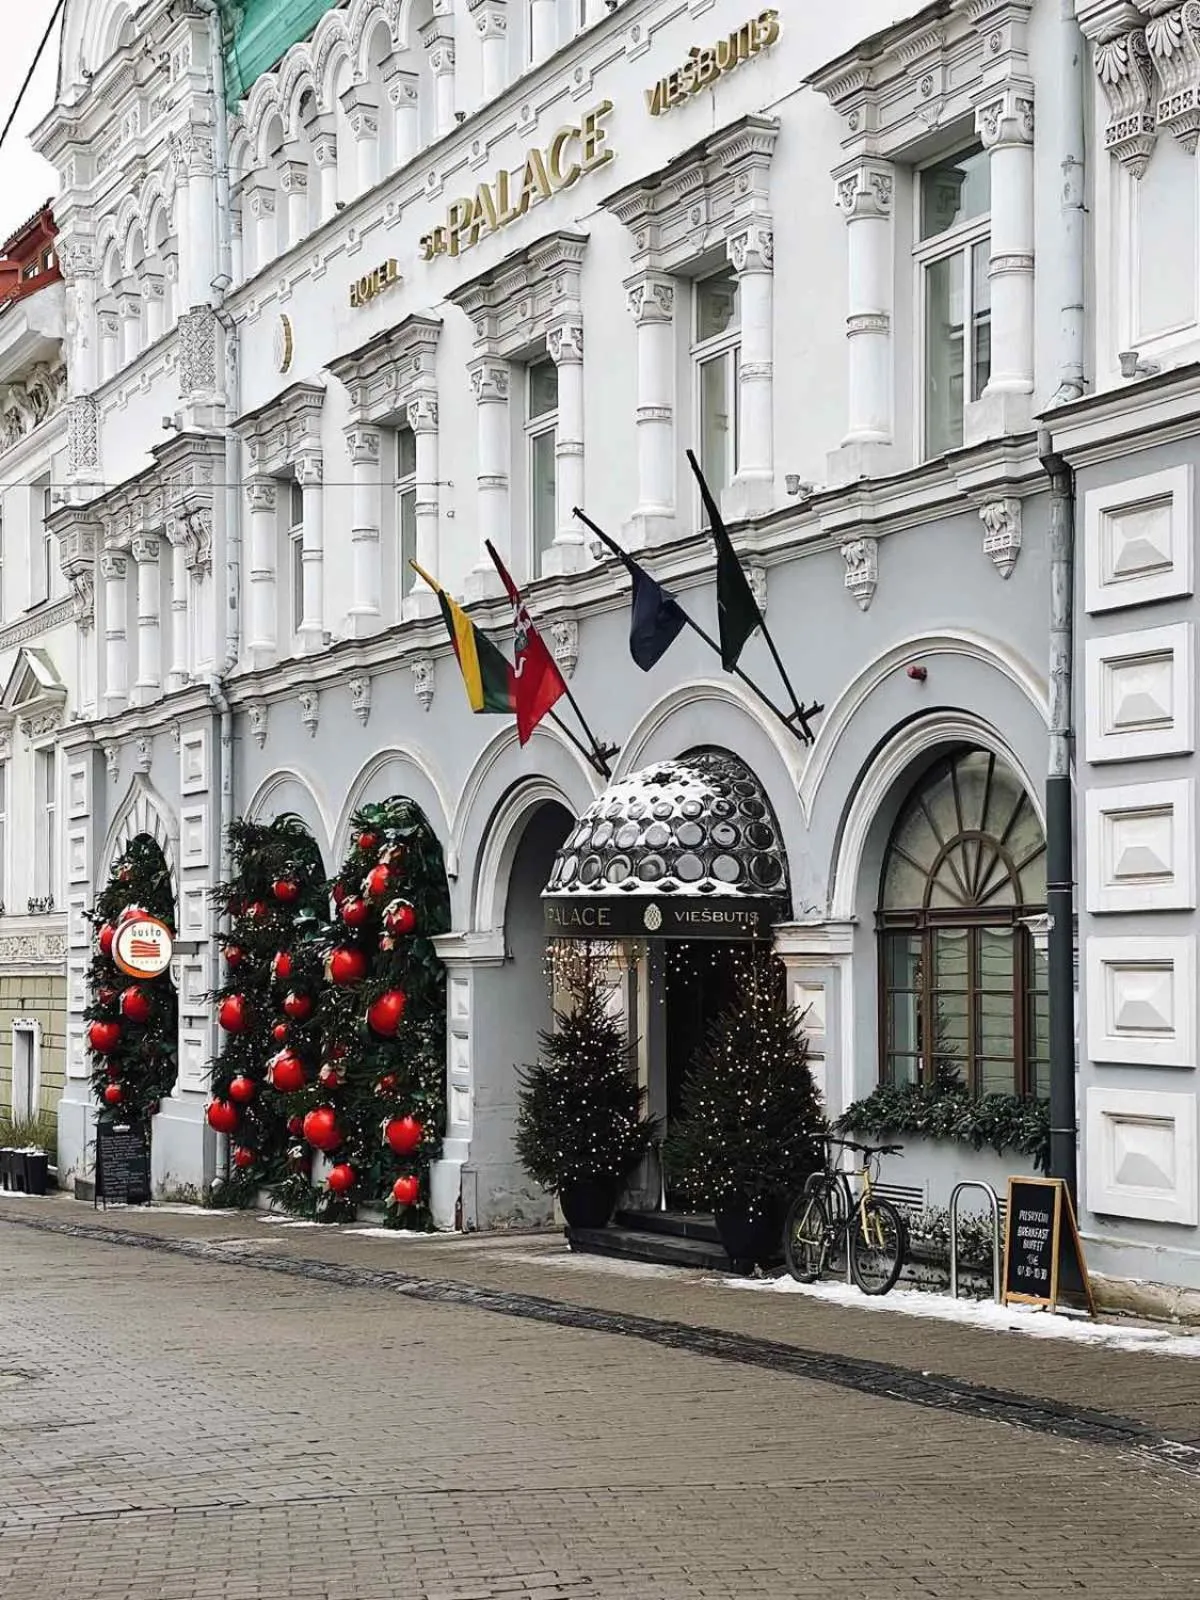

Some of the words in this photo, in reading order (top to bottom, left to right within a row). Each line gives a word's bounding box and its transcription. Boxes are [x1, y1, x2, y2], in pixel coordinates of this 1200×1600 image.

[349, 258, 402, 307] HOTEL
[446, 100, 614, 257] PALACE
[643, 8, 780, 116] VIEŠBUTIS
[547, 907, 611, 926] PALACE
[674, 907, 760, 923] VIEŠBUTIS
[1017, 1226, 1050, 1240] BREAKFAST
[1023, 1239, 1045, 1252] BUFFET
